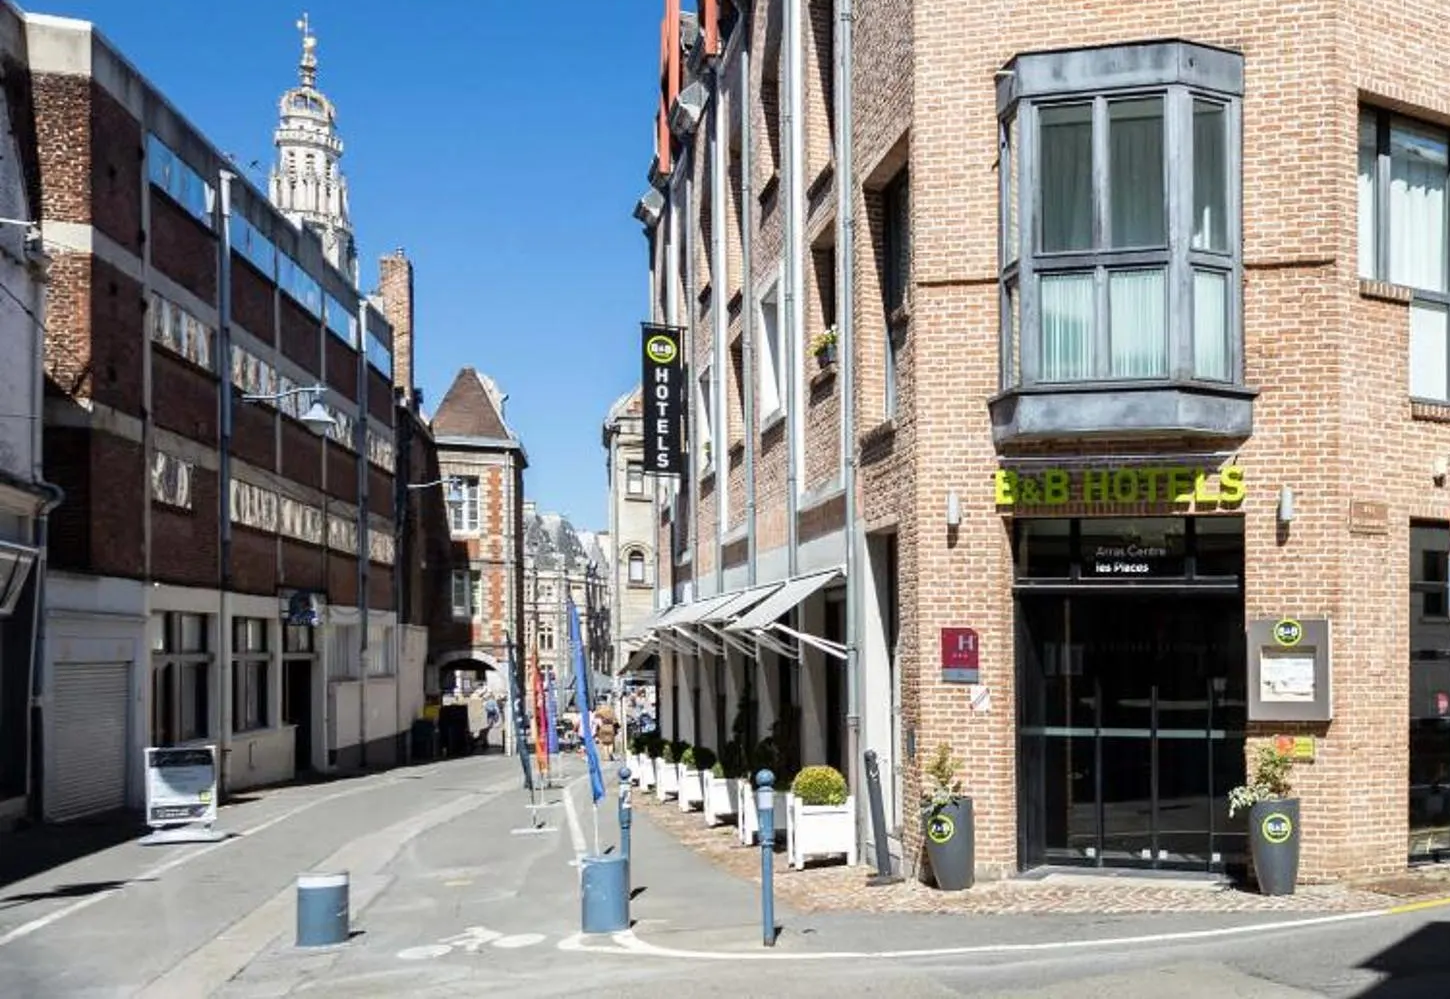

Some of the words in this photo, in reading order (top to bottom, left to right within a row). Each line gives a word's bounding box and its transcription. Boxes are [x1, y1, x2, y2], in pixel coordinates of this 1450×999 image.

[655, 368, 669, 469] HOTELS
[995, 468, 1069, 505] B&B
[1084, 466, 1246, 503] HOTELS
[958, 635, 973, 651] H
